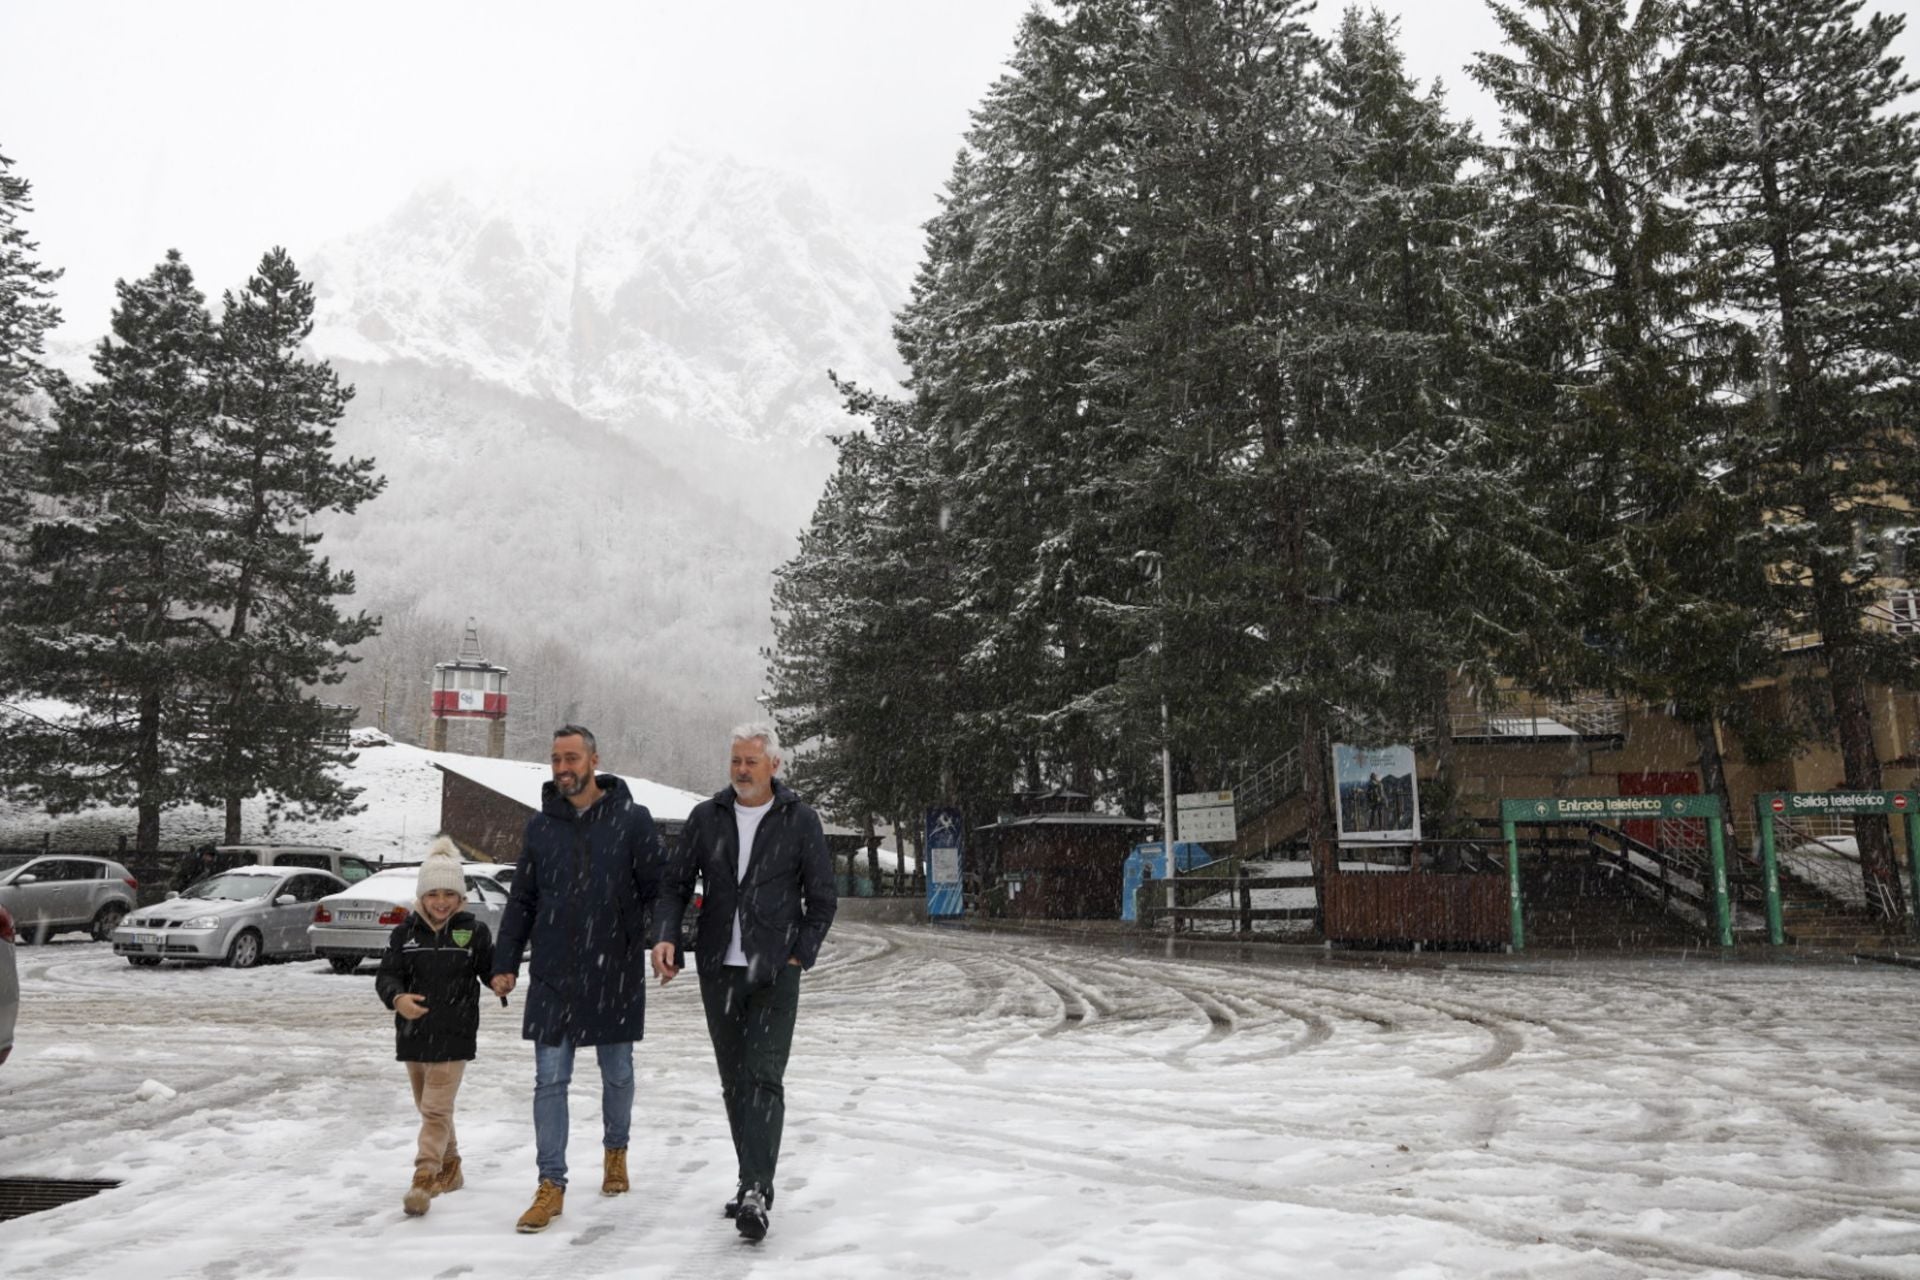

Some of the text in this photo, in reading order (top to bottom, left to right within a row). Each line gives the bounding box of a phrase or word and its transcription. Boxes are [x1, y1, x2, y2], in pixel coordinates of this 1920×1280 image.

[1558, 798, 1661, 811] Entrada teleférico
[1793, 794, 1885, 808] Salida teleférico
